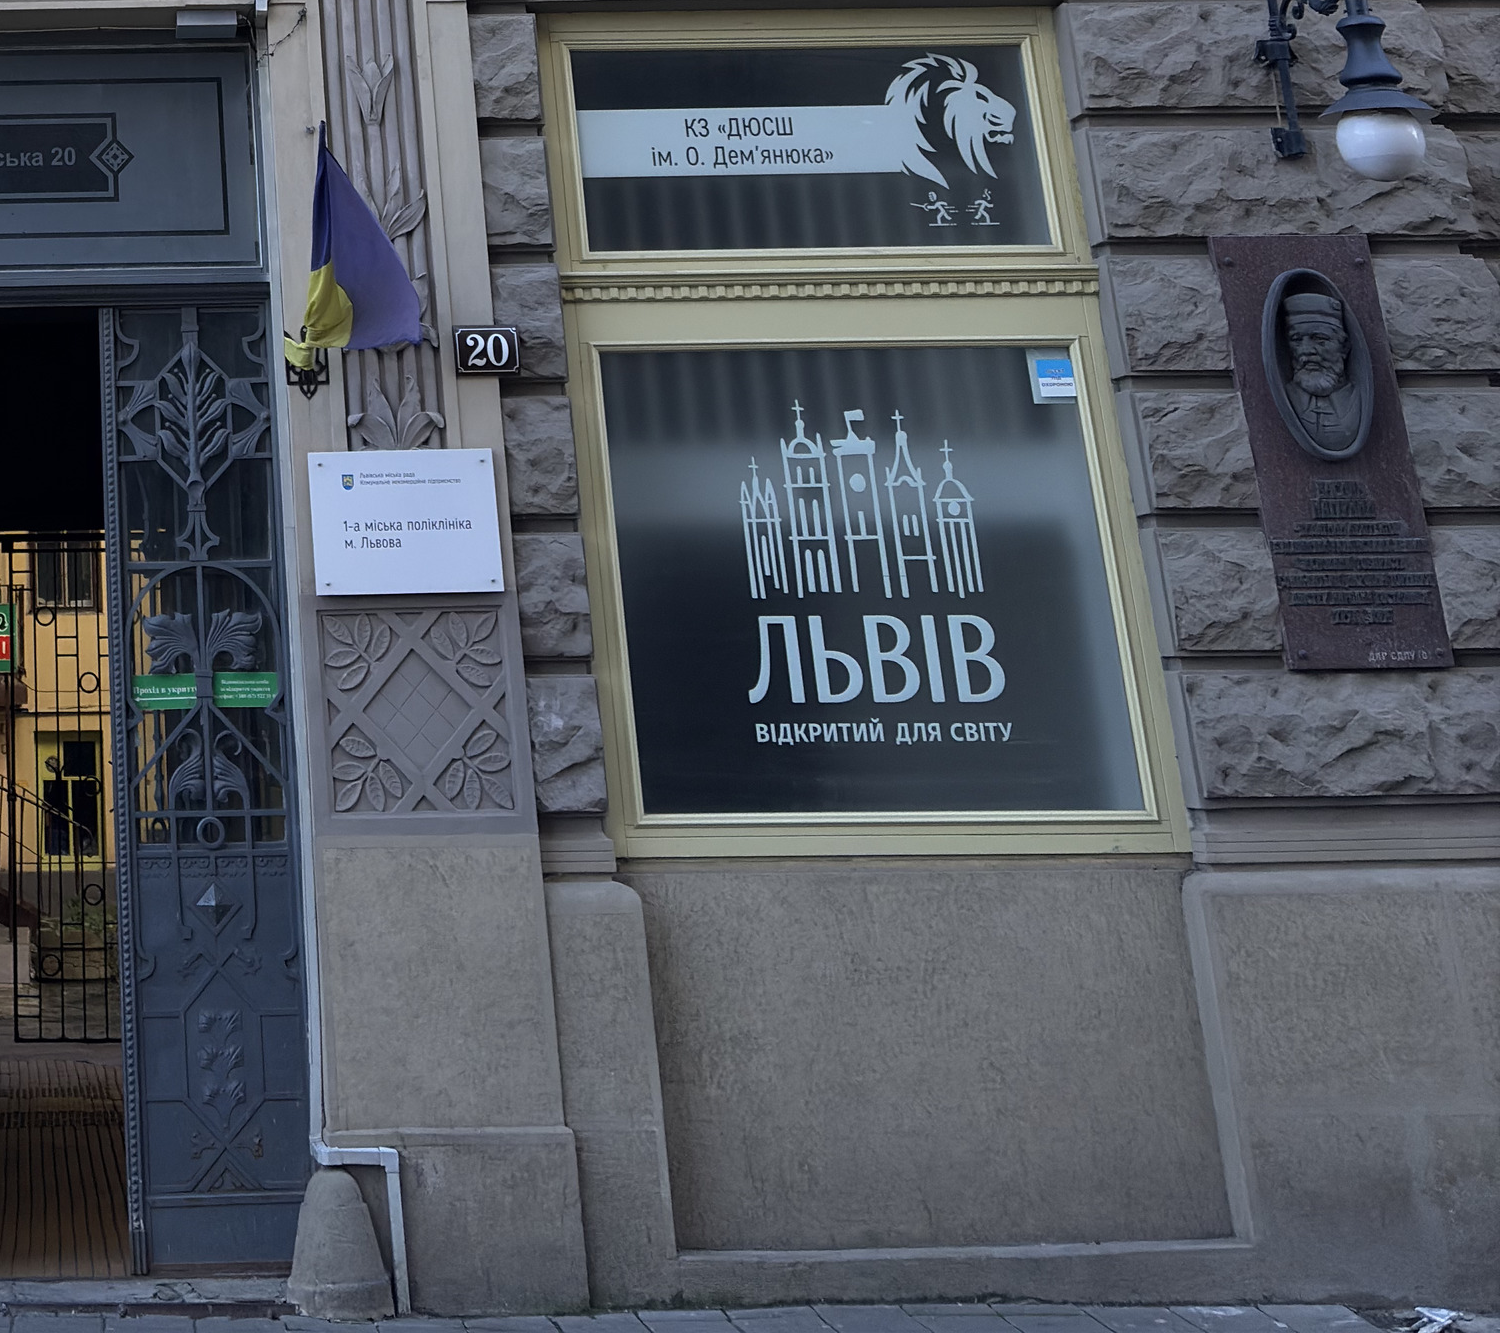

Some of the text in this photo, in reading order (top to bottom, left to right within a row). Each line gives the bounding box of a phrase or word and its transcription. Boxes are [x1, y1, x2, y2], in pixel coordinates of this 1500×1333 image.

[684, 116, 794, 140] КЗ «ДЮСШ
[50, 147, 77, 167] 20
[651, 145, 834, 170] ім. О. Дем'янюка»
[465, 332, 510, 367] 20
[343, 517, 473, 532] 1-а міська поліклініка
[344, 536, 402, 549] м. Львова
[748, 614, 1006, 704] ЛЬВІВ
[754, 717, 1013, 746] ВІДКРИТИЙ ДЛЯ СВІТУ
